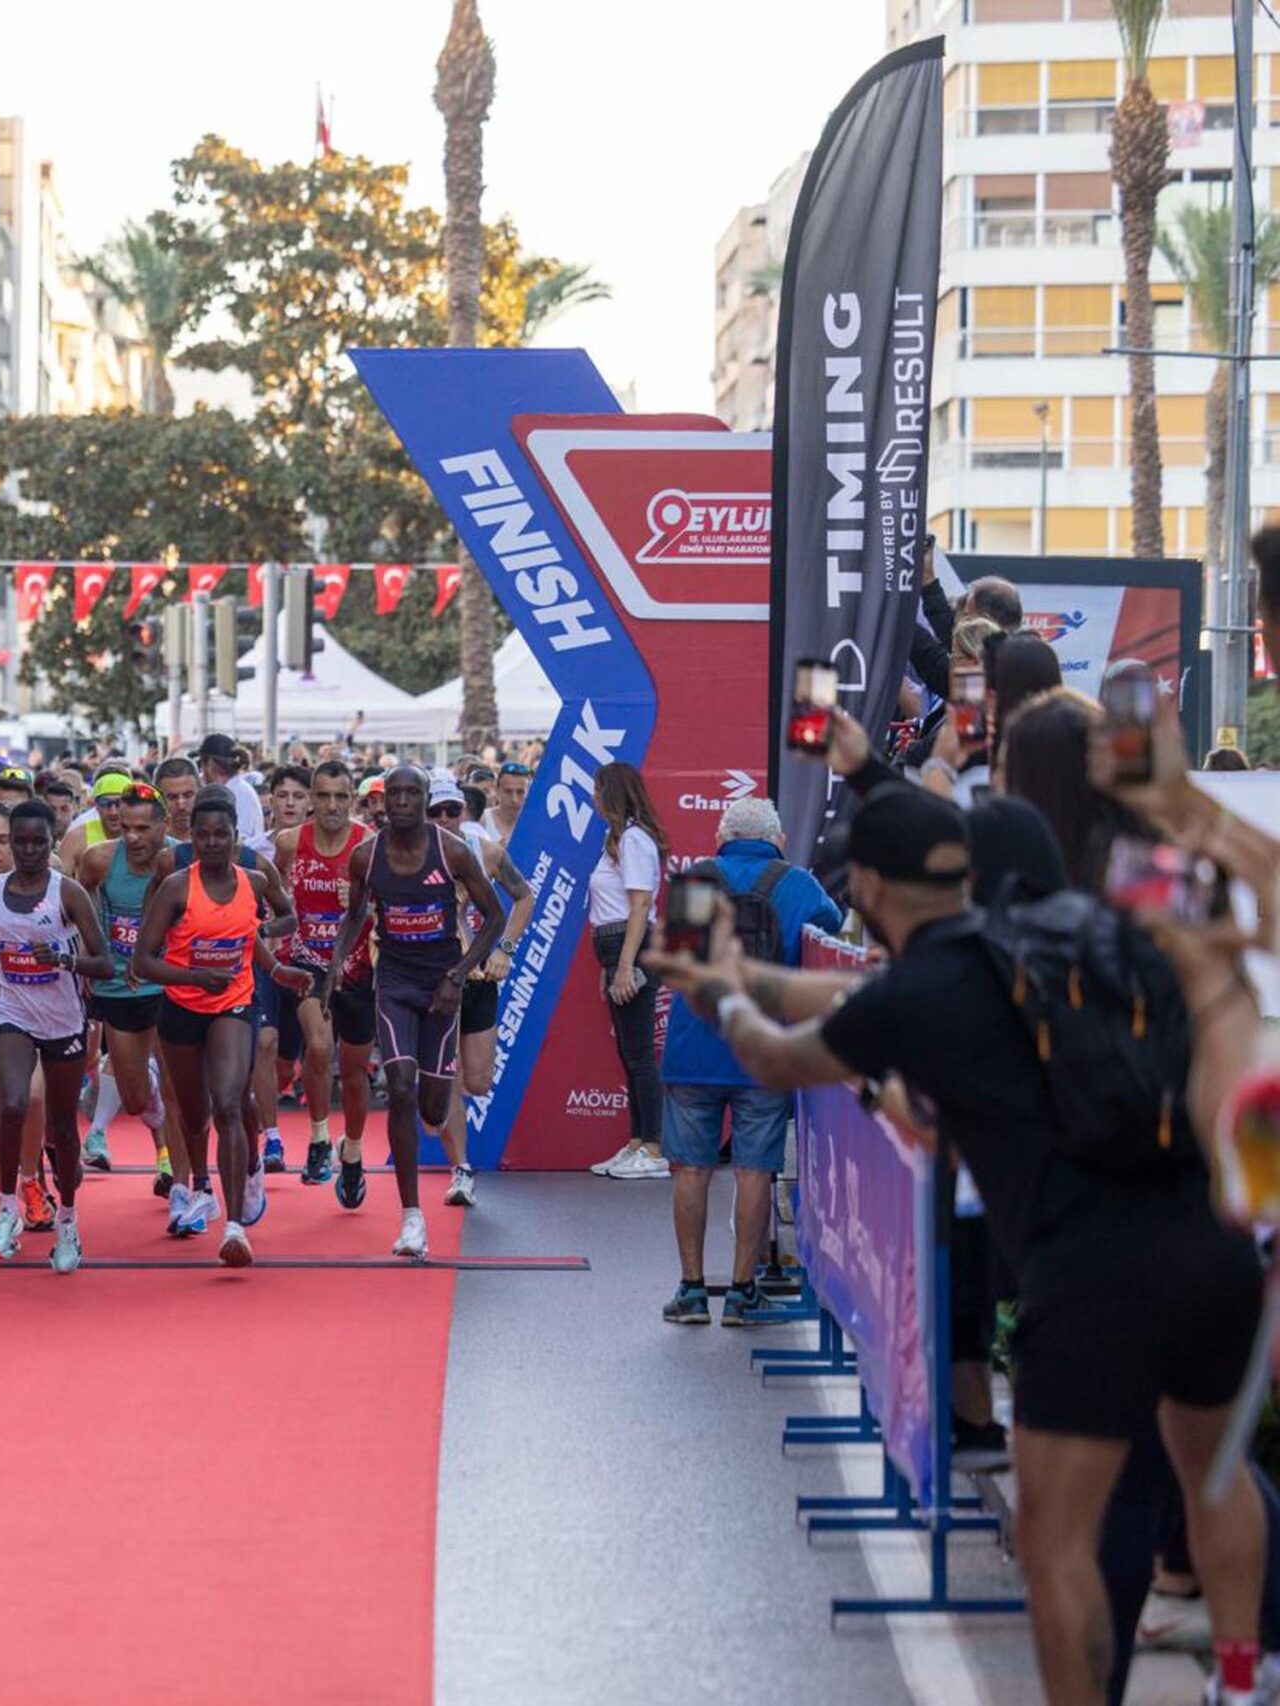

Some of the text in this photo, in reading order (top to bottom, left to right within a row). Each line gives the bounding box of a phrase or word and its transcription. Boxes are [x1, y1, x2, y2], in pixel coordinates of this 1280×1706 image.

[823, 292, 866, 608] TIMING
[894, 287, 924, 592] RACE RESULT
[439, 448, 612, 653] FINISH
[880, 489, 895, 591] POWERED BY
[546, 698, 627, 843] 21K
[303, 875, 341, 892] TÜRKİ
[307, 922, 339, 938] 244
[466, 1049, 510, 1133] ZAER
[497, 966, 539, 1048] SENİN
[526, 867, 577, 974] ELİNDE!
